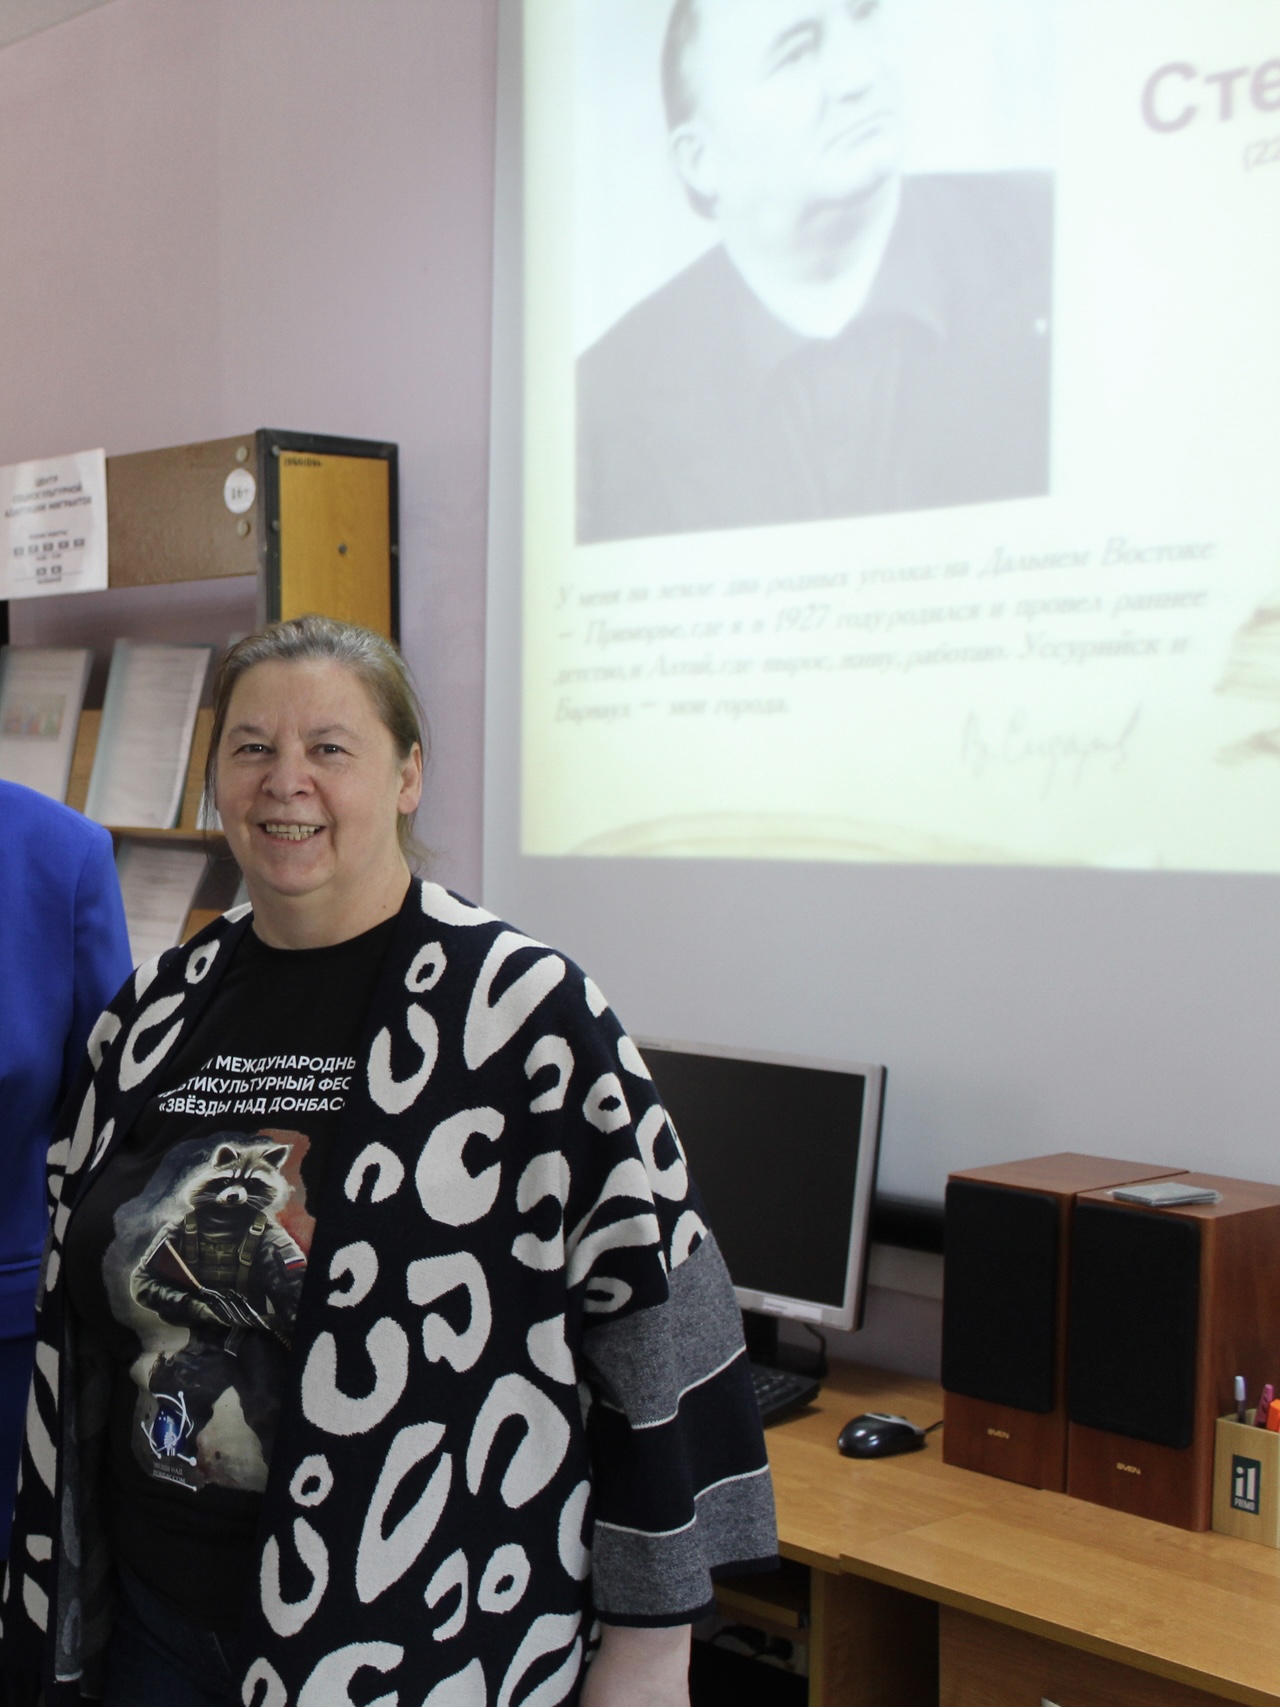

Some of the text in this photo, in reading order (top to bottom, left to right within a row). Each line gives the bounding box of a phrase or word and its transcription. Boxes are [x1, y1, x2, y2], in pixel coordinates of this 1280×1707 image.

[977, 544, 1091, 580] Дальнем
[1101, 536, 1218, 566] Востоке
[775, 602, 833, 633] 1927
[1110, 589, 1210, 620] раннее
[1015, 629, 1162, 667] Уссурийск
[233, 1098, 267, 1114] НАД
[267, 1096, 346, 1115] ДОНБАС
